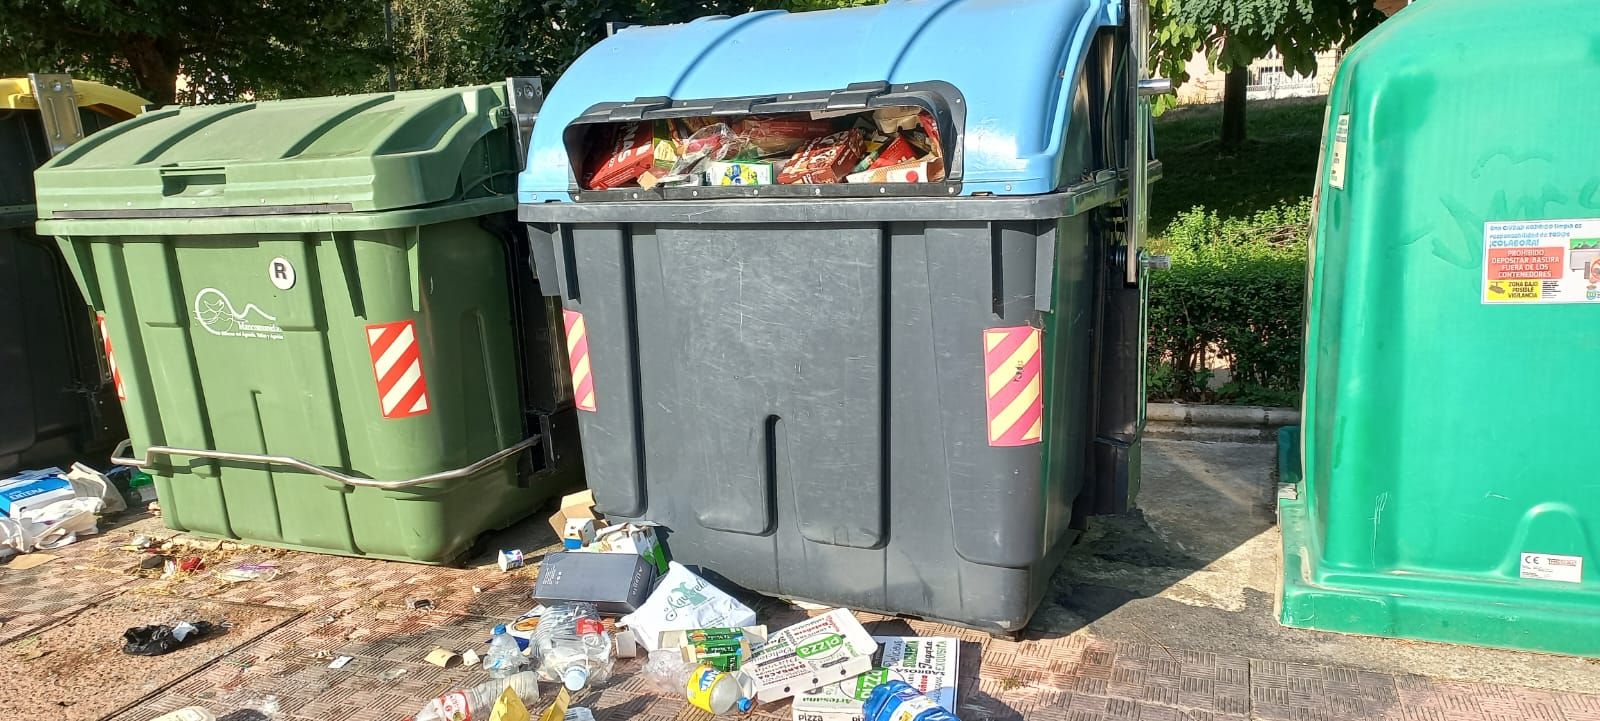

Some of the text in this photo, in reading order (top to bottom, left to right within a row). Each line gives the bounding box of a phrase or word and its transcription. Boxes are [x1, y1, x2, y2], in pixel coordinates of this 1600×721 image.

[1507, 249, 1545, 257] PROHIBIDO
[274, 262, 287, 280] R
[801, 635, 840, 655] pizza
[798, 713, 824, 721] pizza
